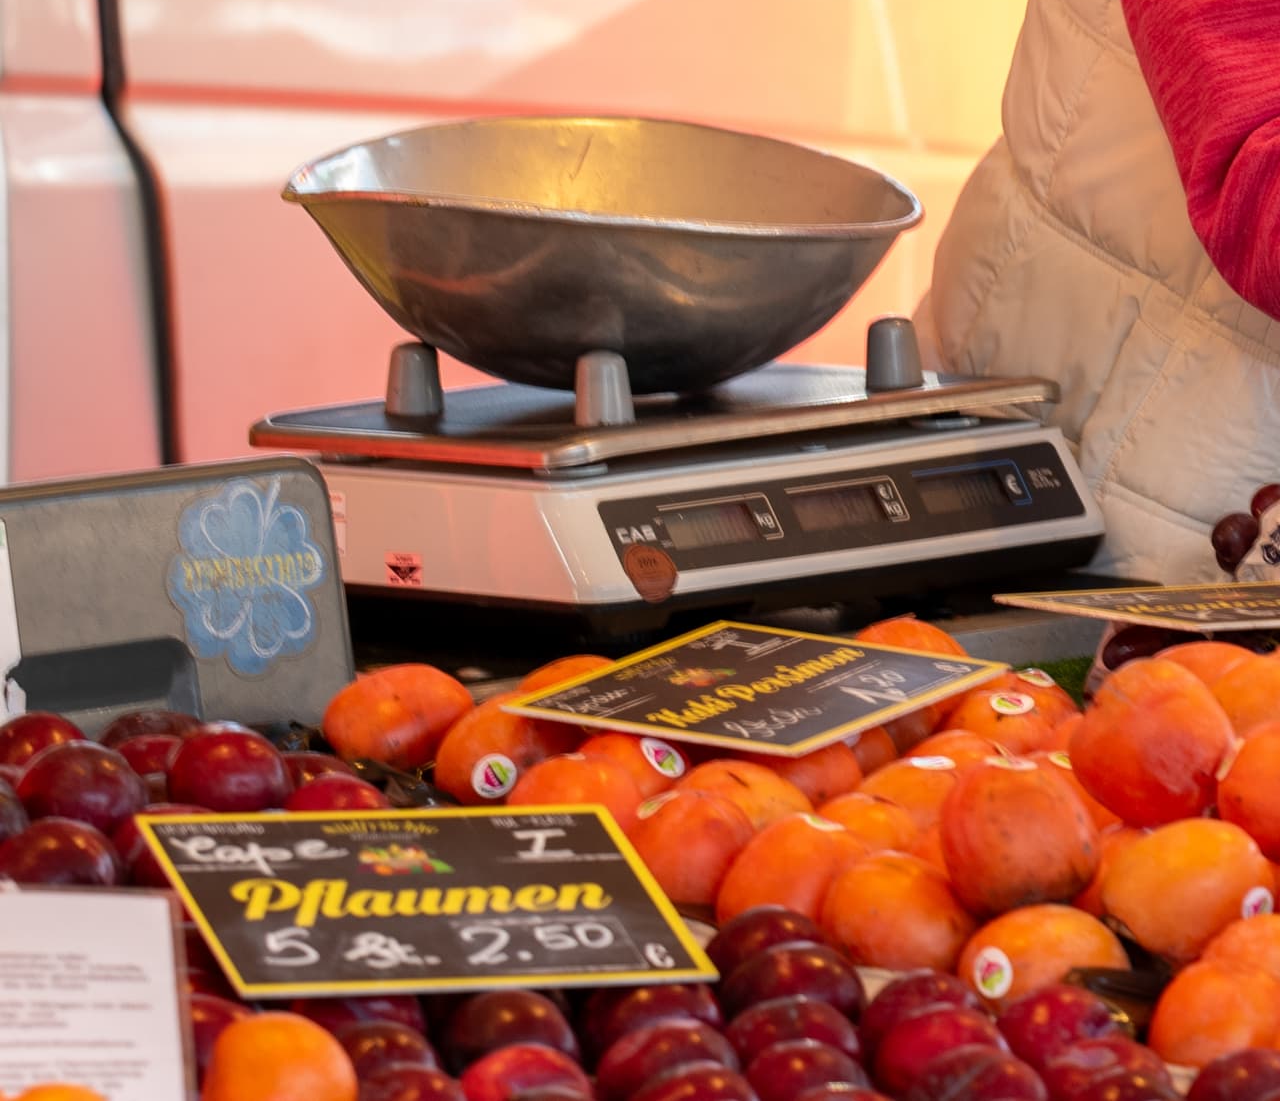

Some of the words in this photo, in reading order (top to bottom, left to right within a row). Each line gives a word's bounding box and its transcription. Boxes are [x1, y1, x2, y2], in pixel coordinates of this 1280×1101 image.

[753, 511, 776, 529] kg
[715, 647, 866, 703] Persimon
[230, 878, 612, 927] Pflaumen
[264, 927, 320, 967] 5
